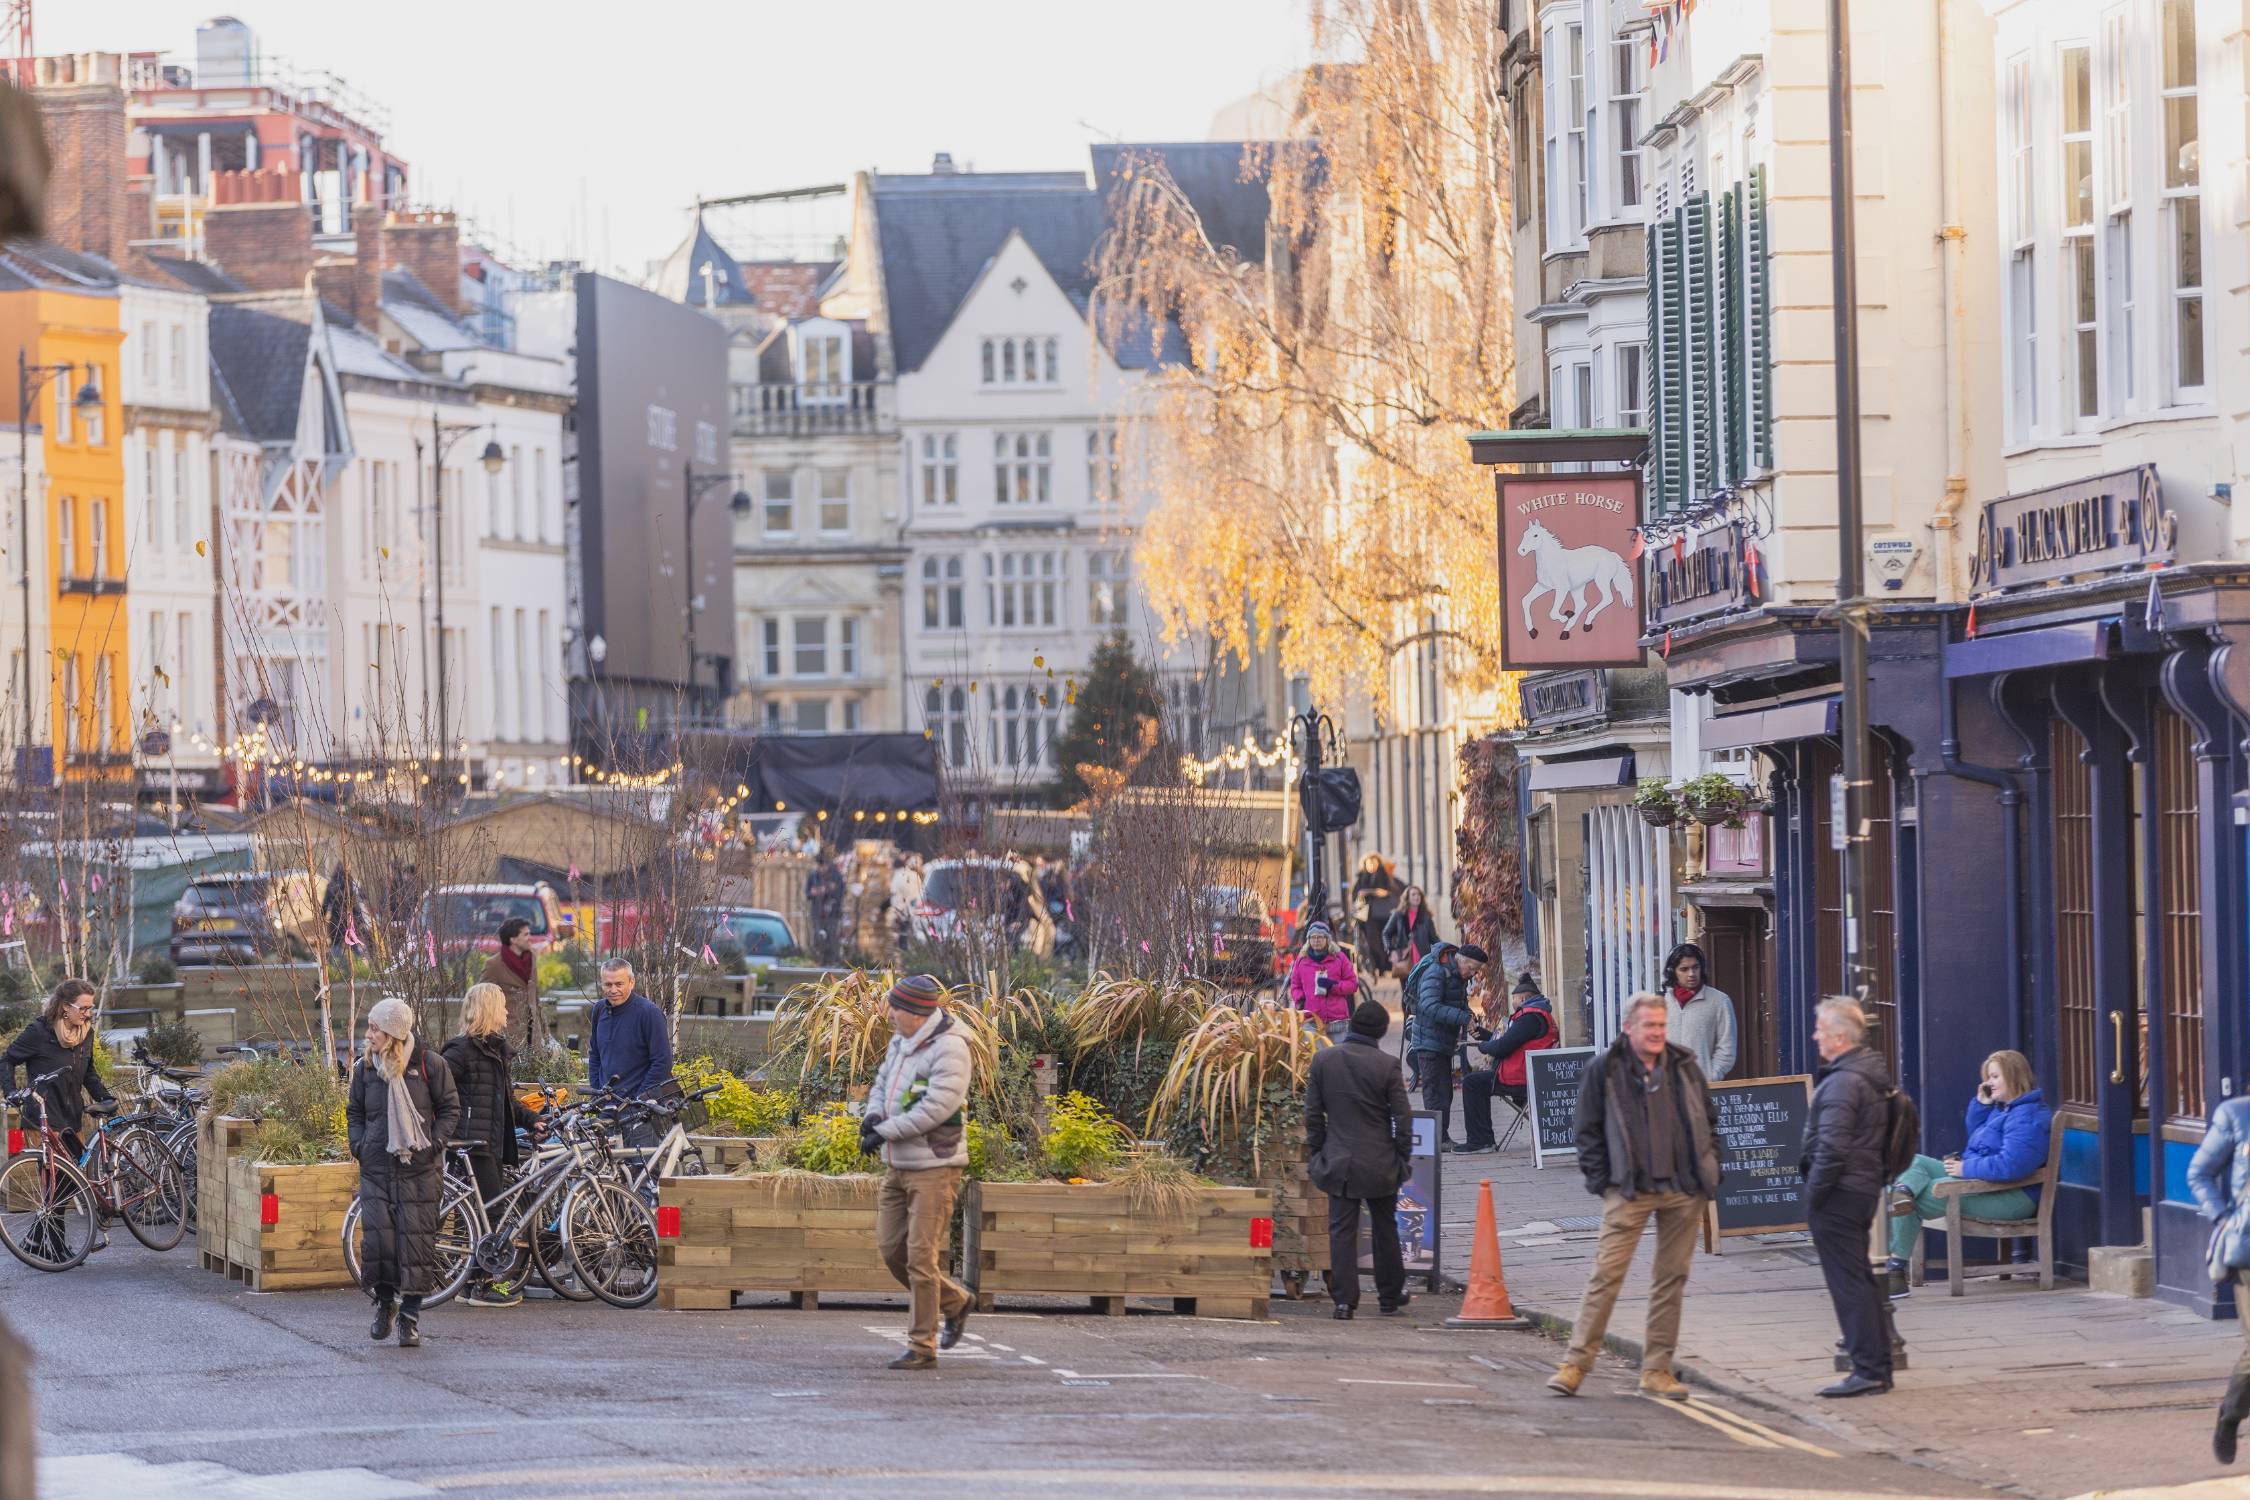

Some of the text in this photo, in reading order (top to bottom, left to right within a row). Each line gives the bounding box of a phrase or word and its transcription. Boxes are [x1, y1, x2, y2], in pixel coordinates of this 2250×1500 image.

[1517, 492, 1624, 515] WHITE HORSE
[2017, 494, 2108, 564] BLACKWELL
